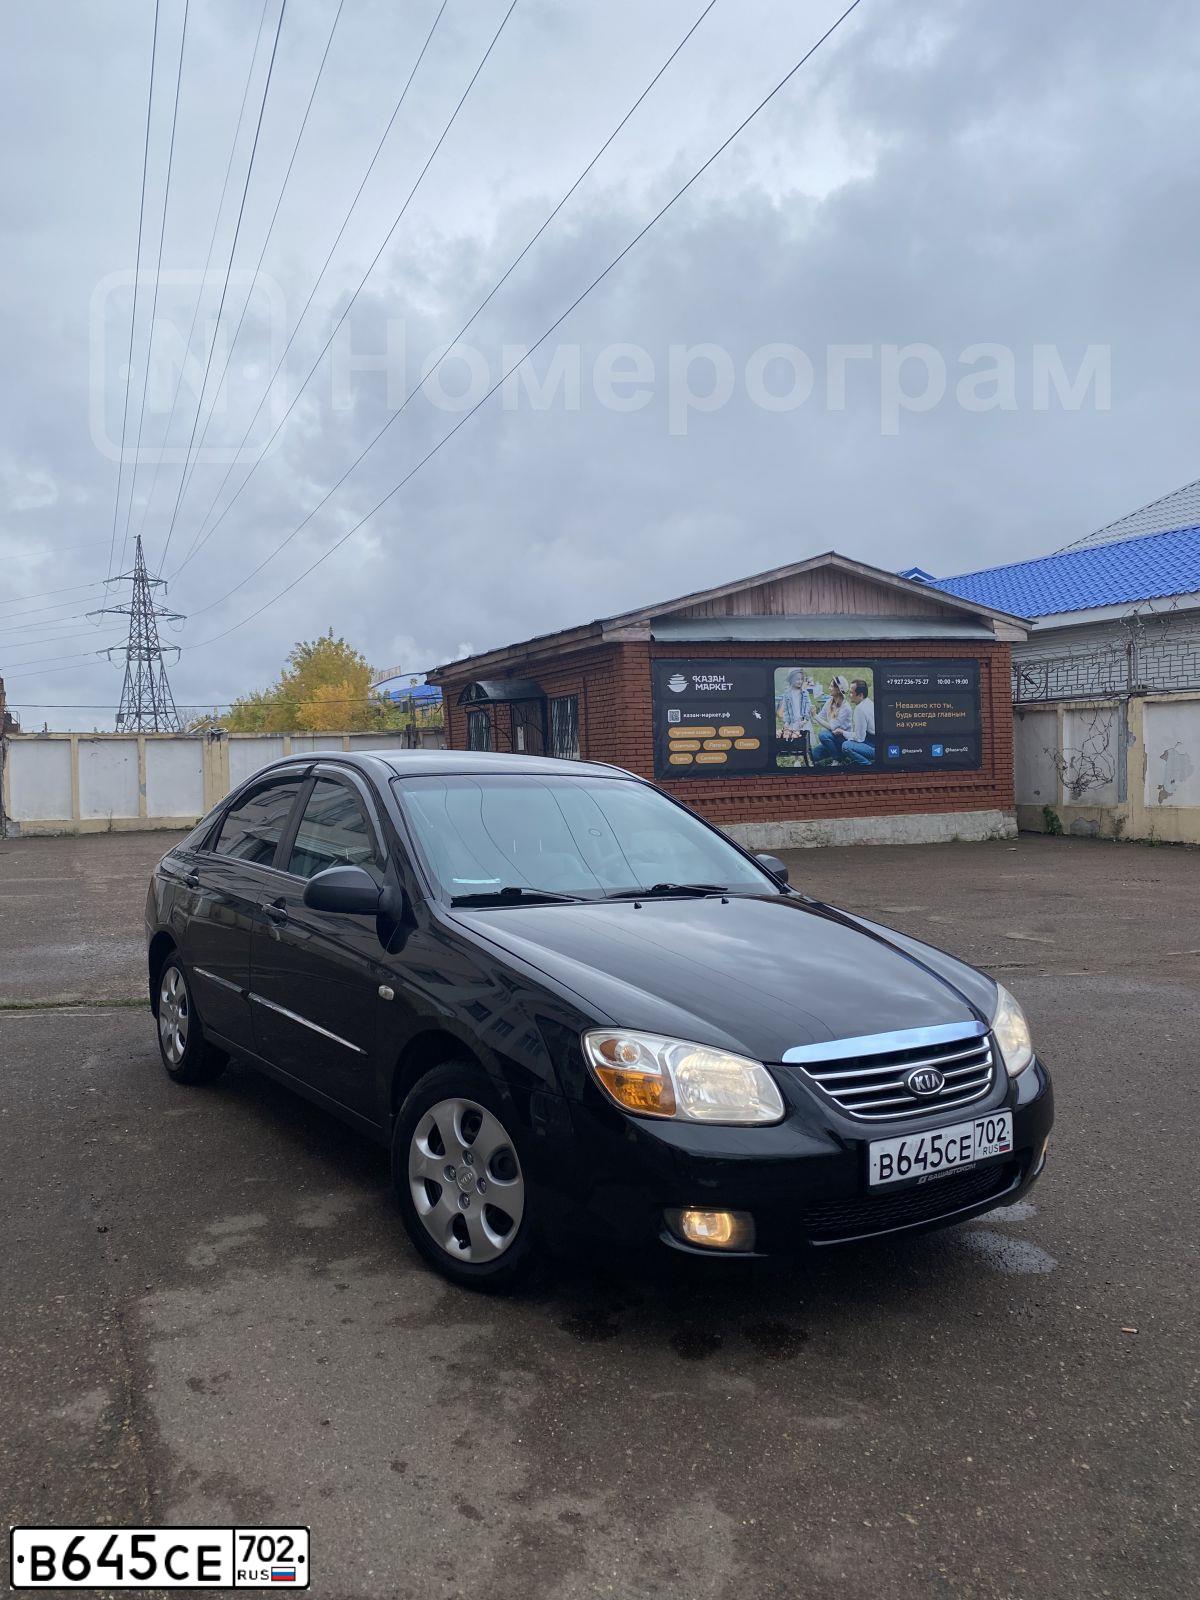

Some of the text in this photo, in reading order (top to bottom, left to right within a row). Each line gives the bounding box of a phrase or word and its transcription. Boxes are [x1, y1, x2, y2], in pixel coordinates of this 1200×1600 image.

[692, 675, 725, 683] КАЗАН
[695, 683, 734, 691] МАРКЕТ
[683, 711, 731, 719] казан-маркет.рф
[895, 711, 913, 720] будь
[913, 711, 936, 719] всегда
[906, 721, 928, 729] кухне
[914, 1073, 940, 1091] KIA
[879, 1117, 1007, 1181] В645СЕ 702
[982, 1145, 999, 1156] RUS
